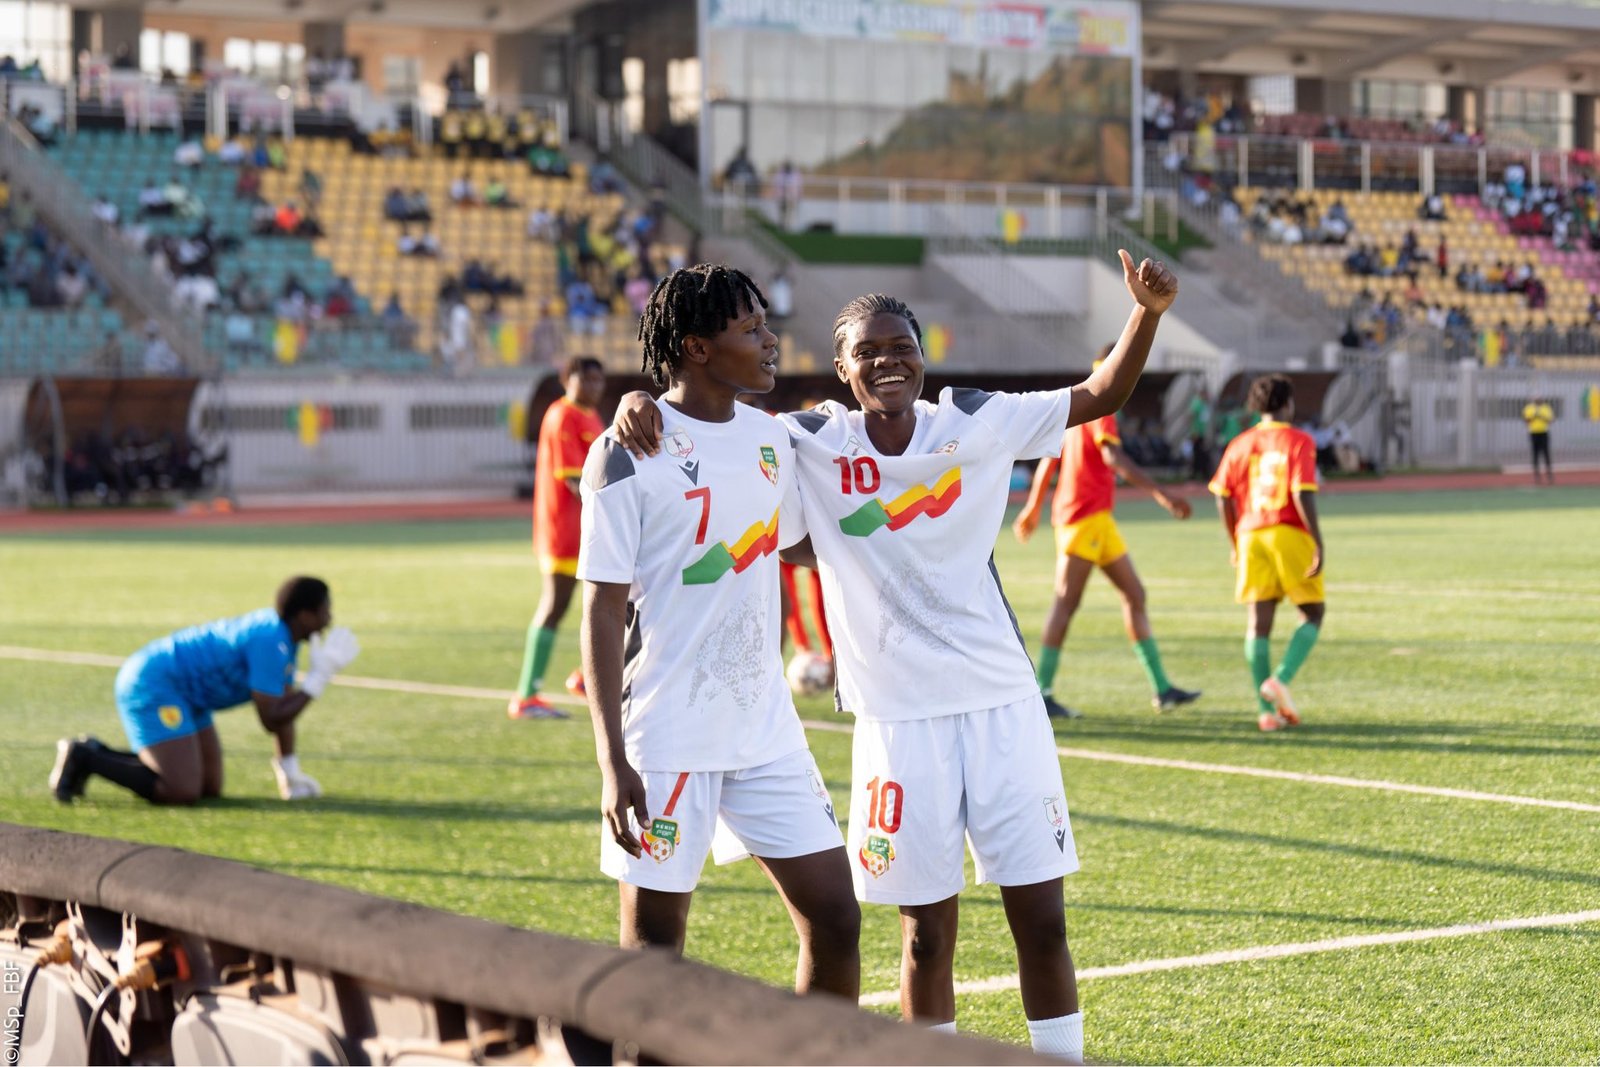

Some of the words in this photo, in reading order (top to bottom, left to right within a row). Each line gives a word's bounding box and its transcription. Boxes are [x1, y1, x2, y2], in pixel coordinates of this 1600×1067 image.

[833, 456, 880, 495] 10
[684, 486, 711, 545] 7
[867, 776, 904, 834] 10
